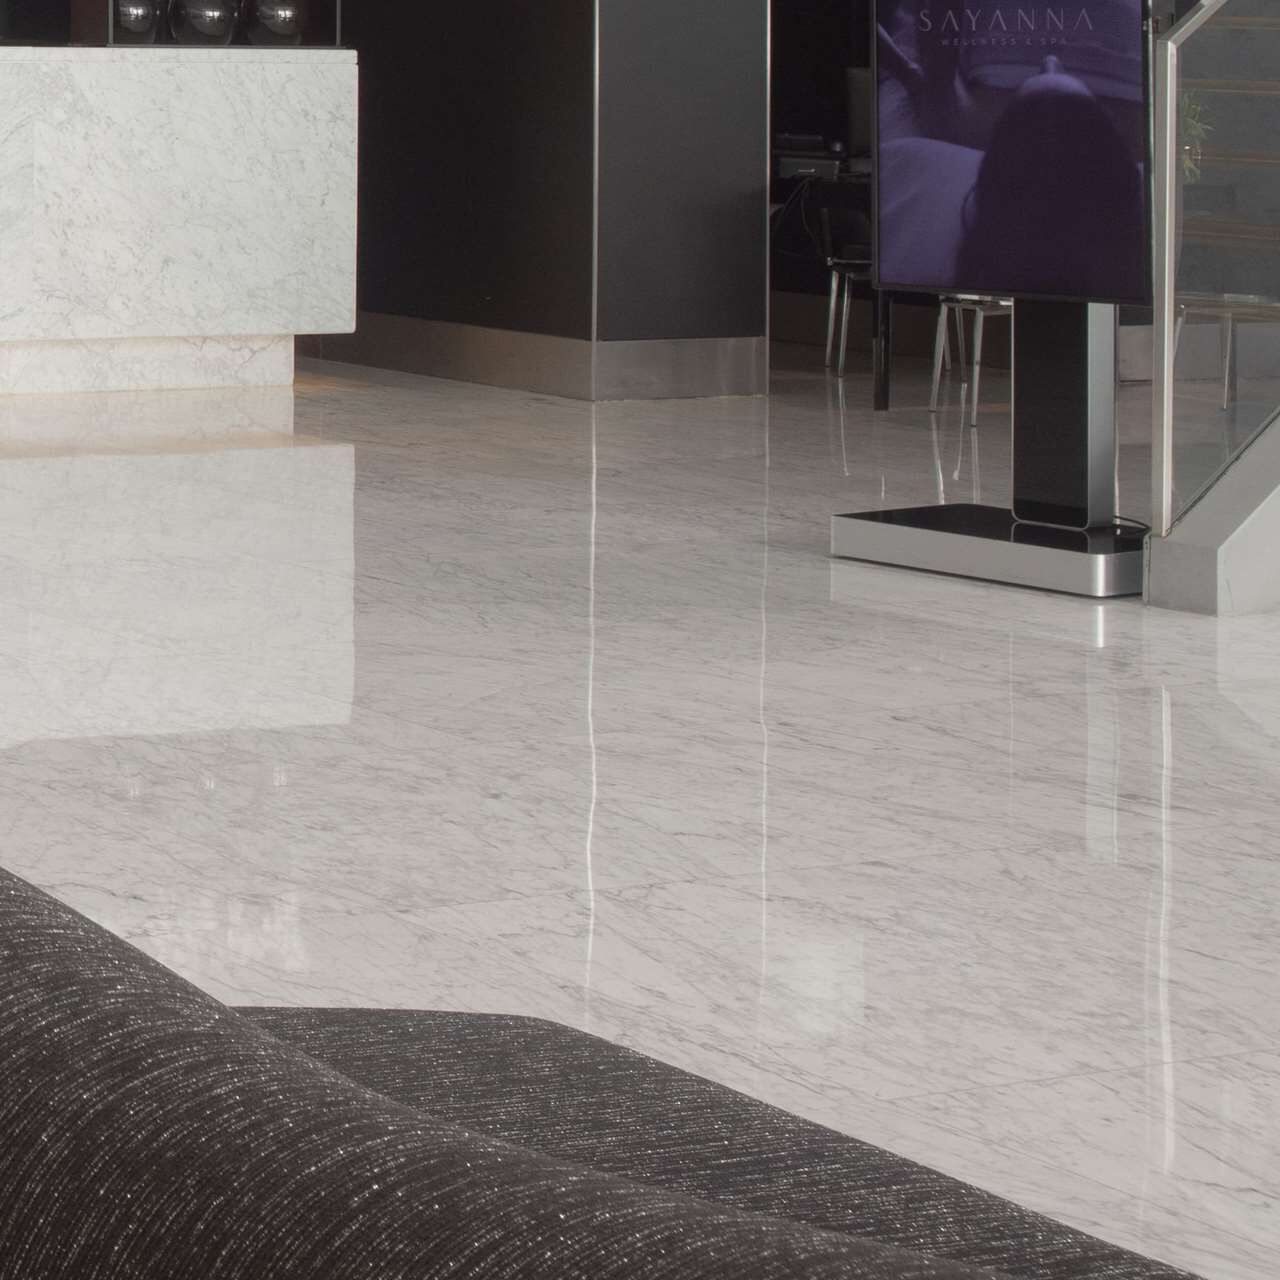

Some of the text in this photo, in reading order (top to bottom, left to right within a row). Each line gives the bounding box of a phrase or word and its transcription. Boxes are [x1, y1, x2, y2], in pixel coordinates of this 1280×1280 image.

[919, 7, 1093, 32] SAYANNA
[941, 37, 1017, 46] WELLNESS
[1040, 37, 1067, 46] SPA
